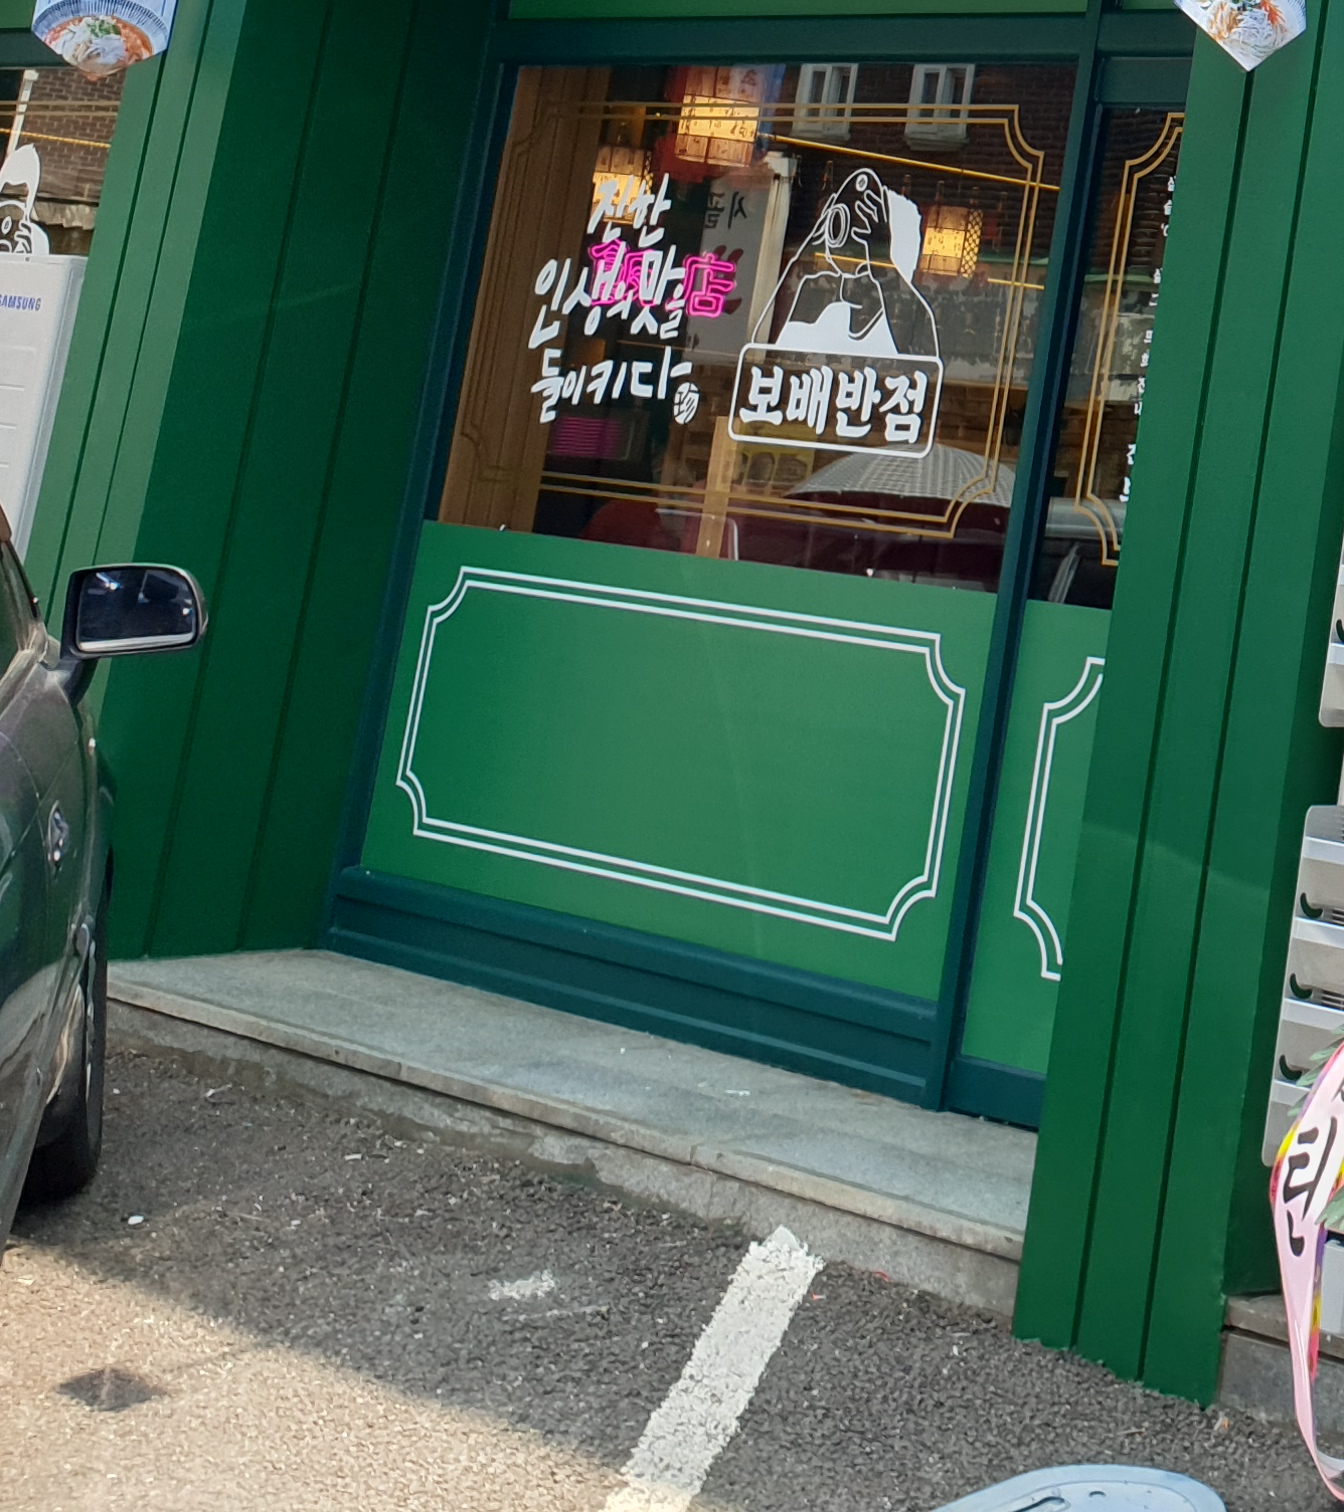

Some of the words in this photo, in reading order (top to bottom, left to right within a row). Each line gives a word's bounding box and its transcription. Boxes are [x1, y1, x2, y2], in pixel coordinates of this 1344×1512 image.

[587, 172, 672, 246] 진한
[530, 346, 693, 424] 들이키다
[739, 364, 928, 445] 보배반점
